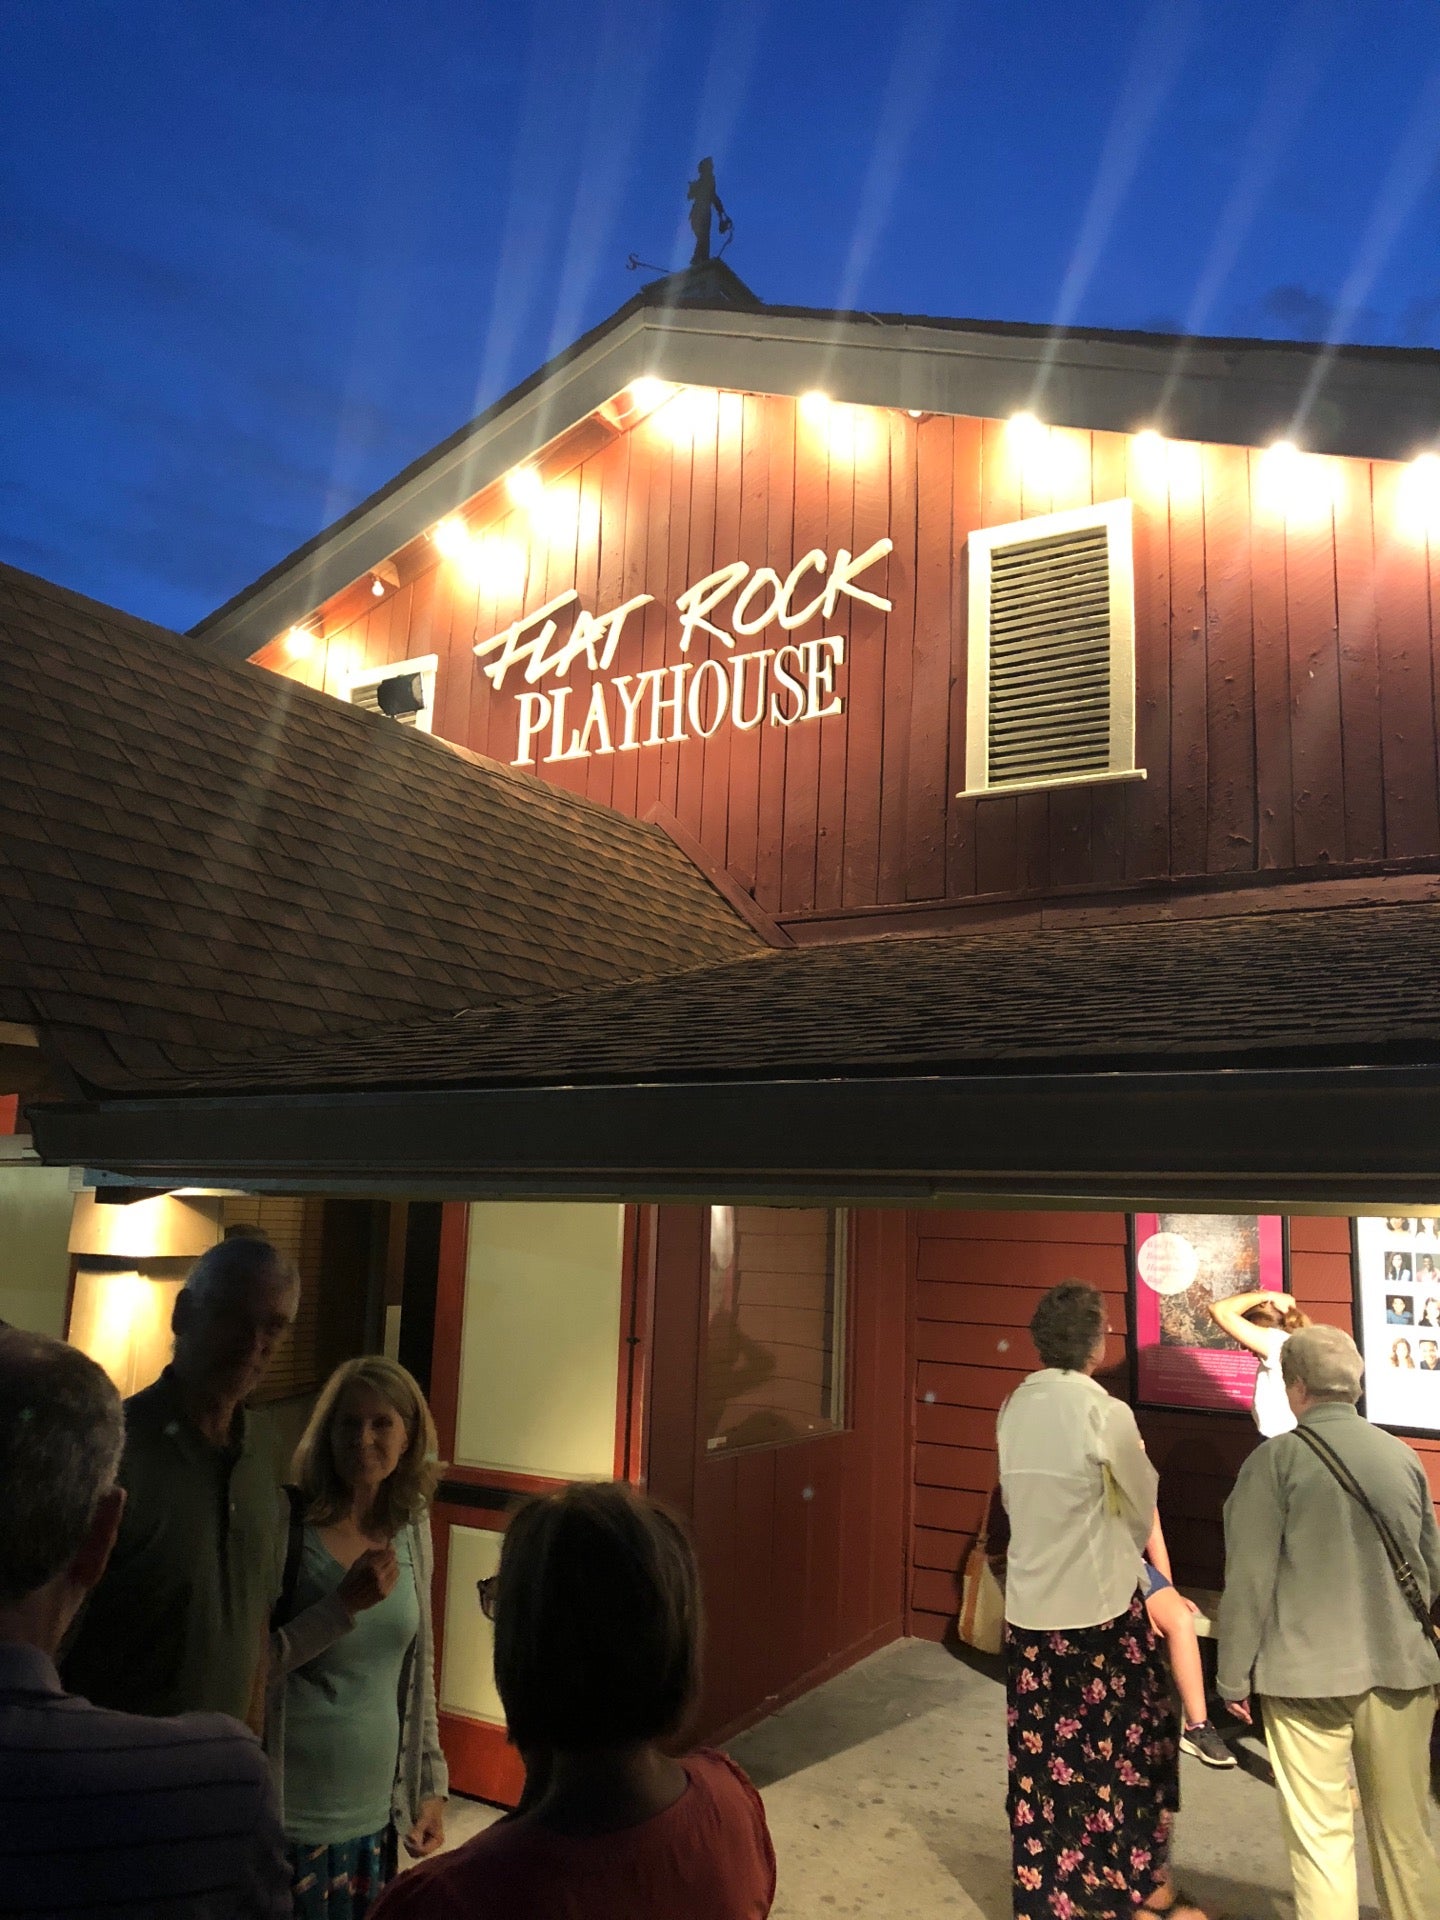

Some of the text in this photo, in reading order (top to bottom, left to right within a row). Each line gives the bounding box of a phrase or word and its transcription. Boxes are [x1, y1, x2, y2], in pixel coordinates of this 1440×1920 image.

[472, 538, 893, 690] FLAT ROCK
[510, 635, 845, 766] PLAYHOUSE
